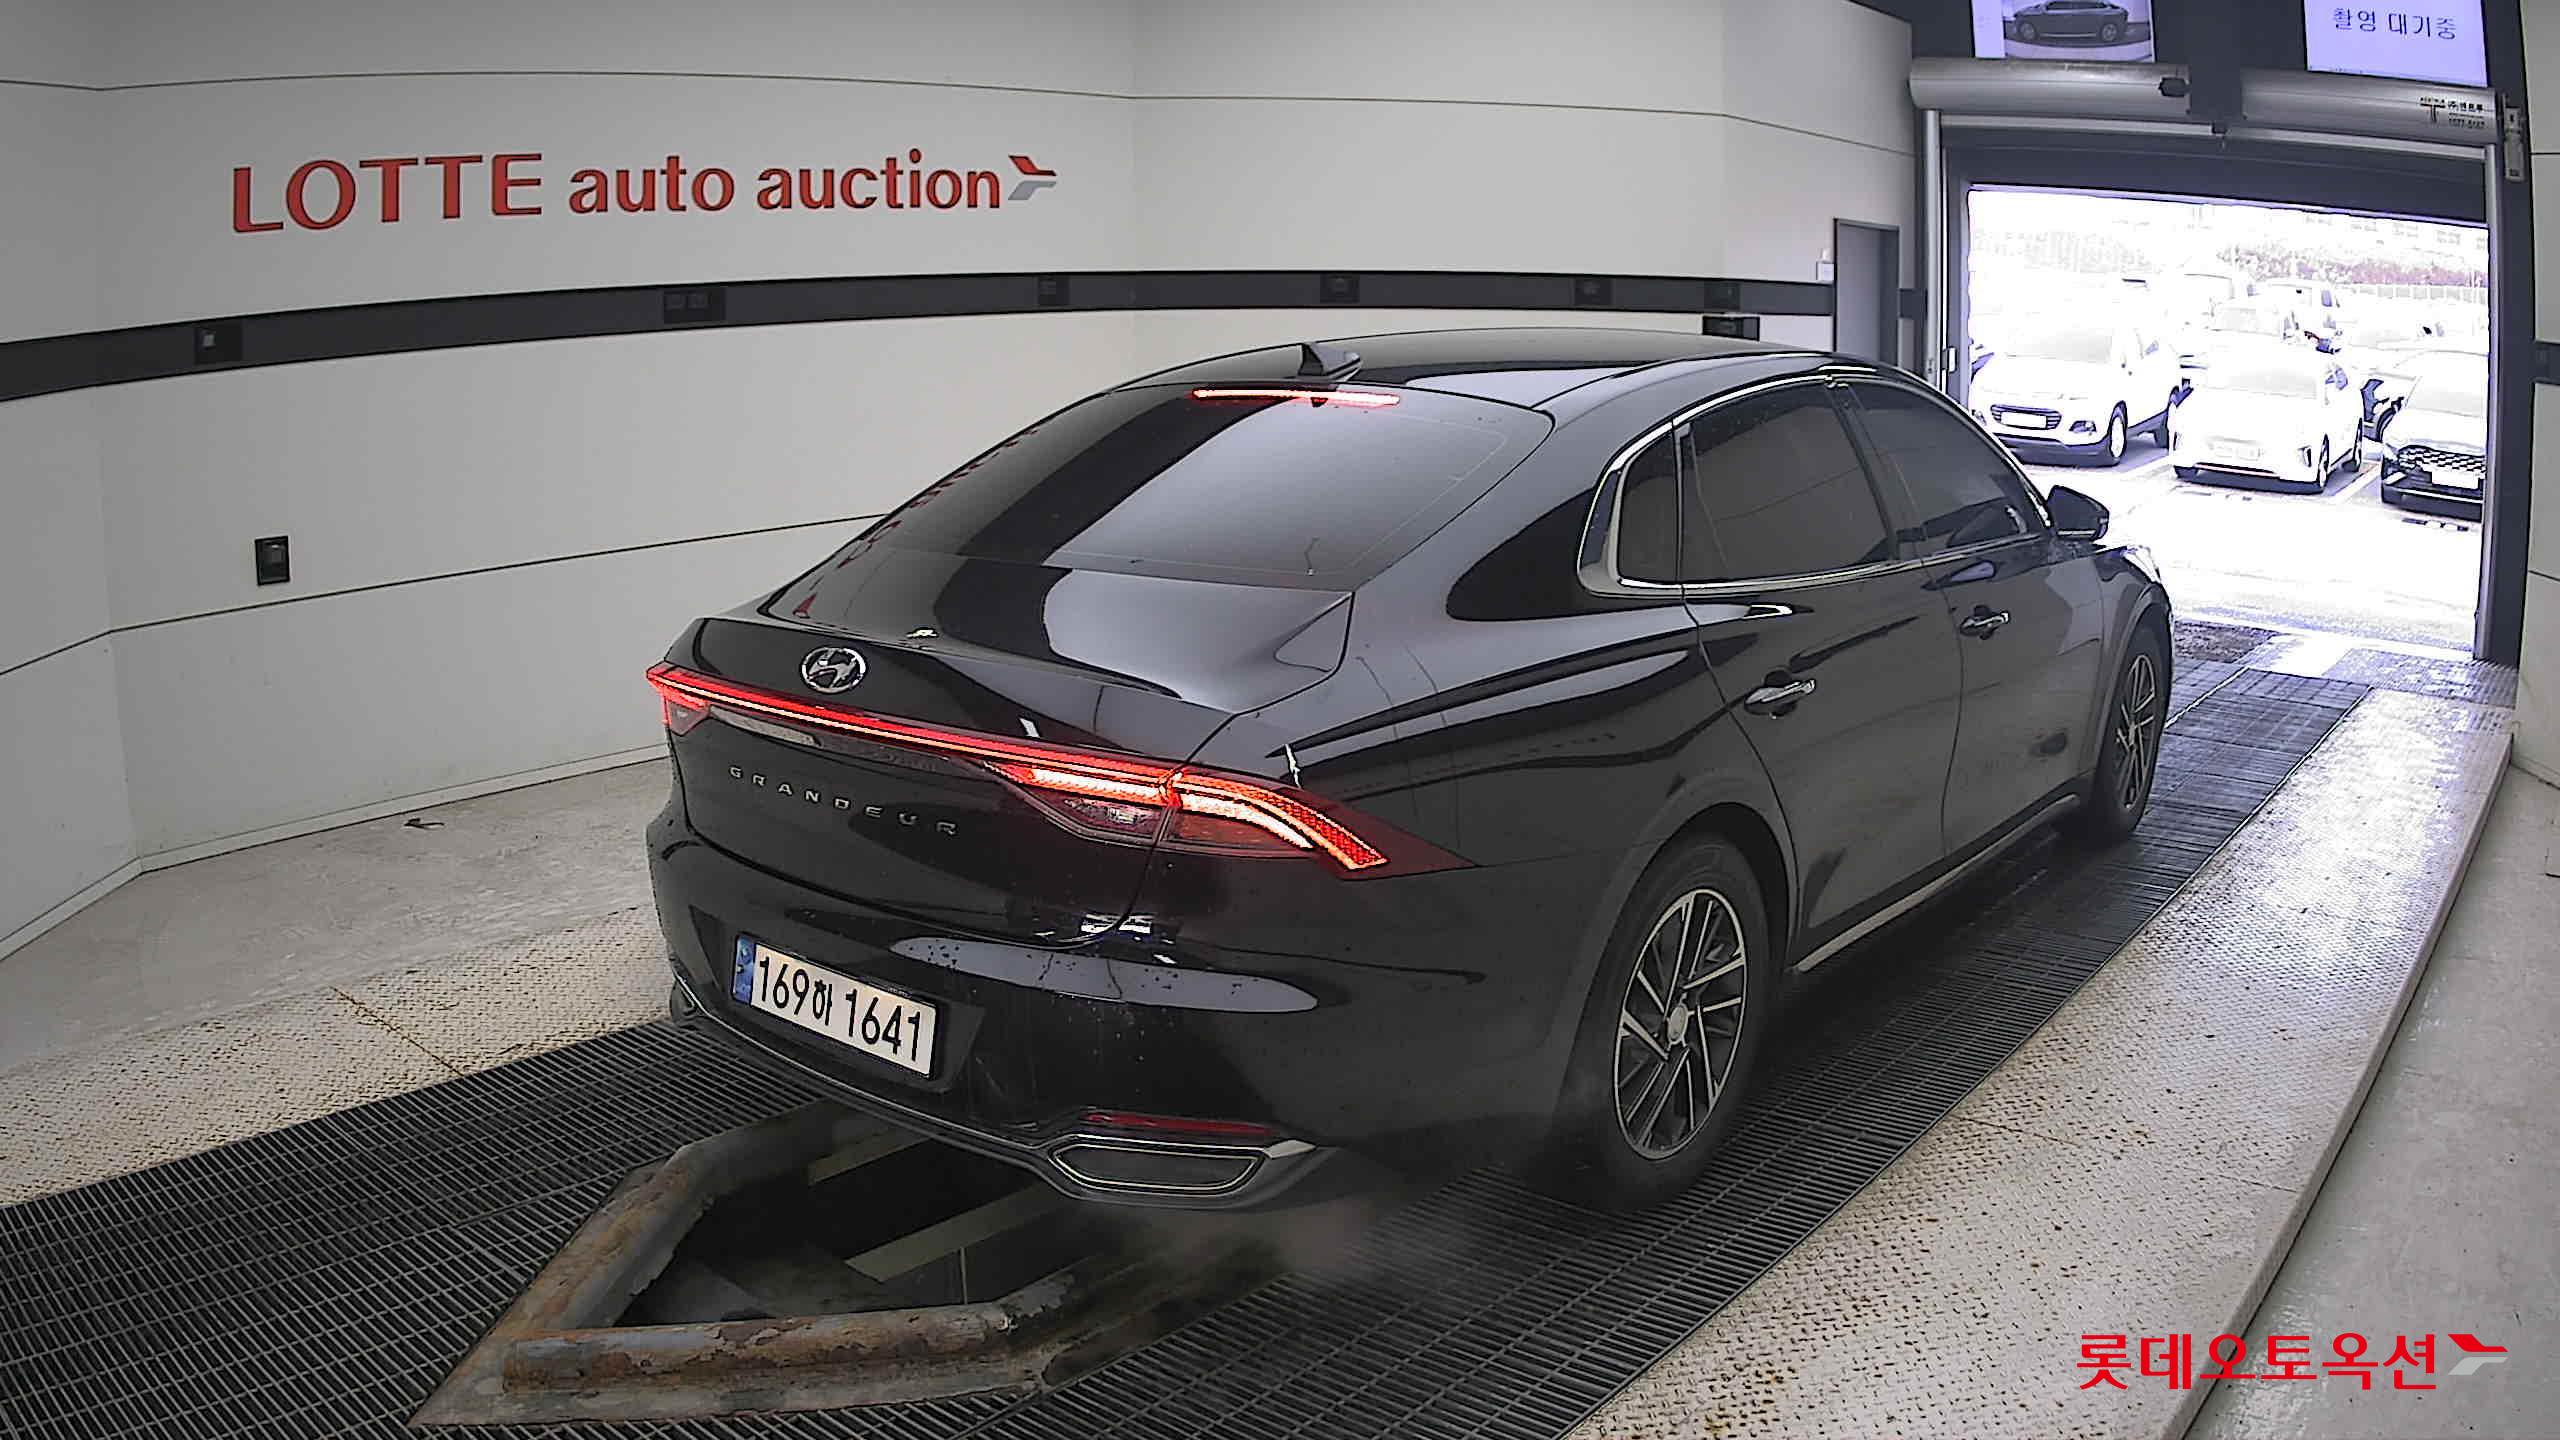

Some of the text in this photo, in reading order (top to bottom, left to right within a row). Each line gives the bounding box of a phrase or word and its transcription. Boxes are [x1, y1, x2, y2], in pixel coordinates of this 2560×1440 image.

[2334, 7, 2457, 40] 촬영 대기중
[234, 150, 1002, 233] LOTTE auto auction
[729, 766, 957, 836] GRANDEUR
[758, 955, 922, 1062] 169하 1641
